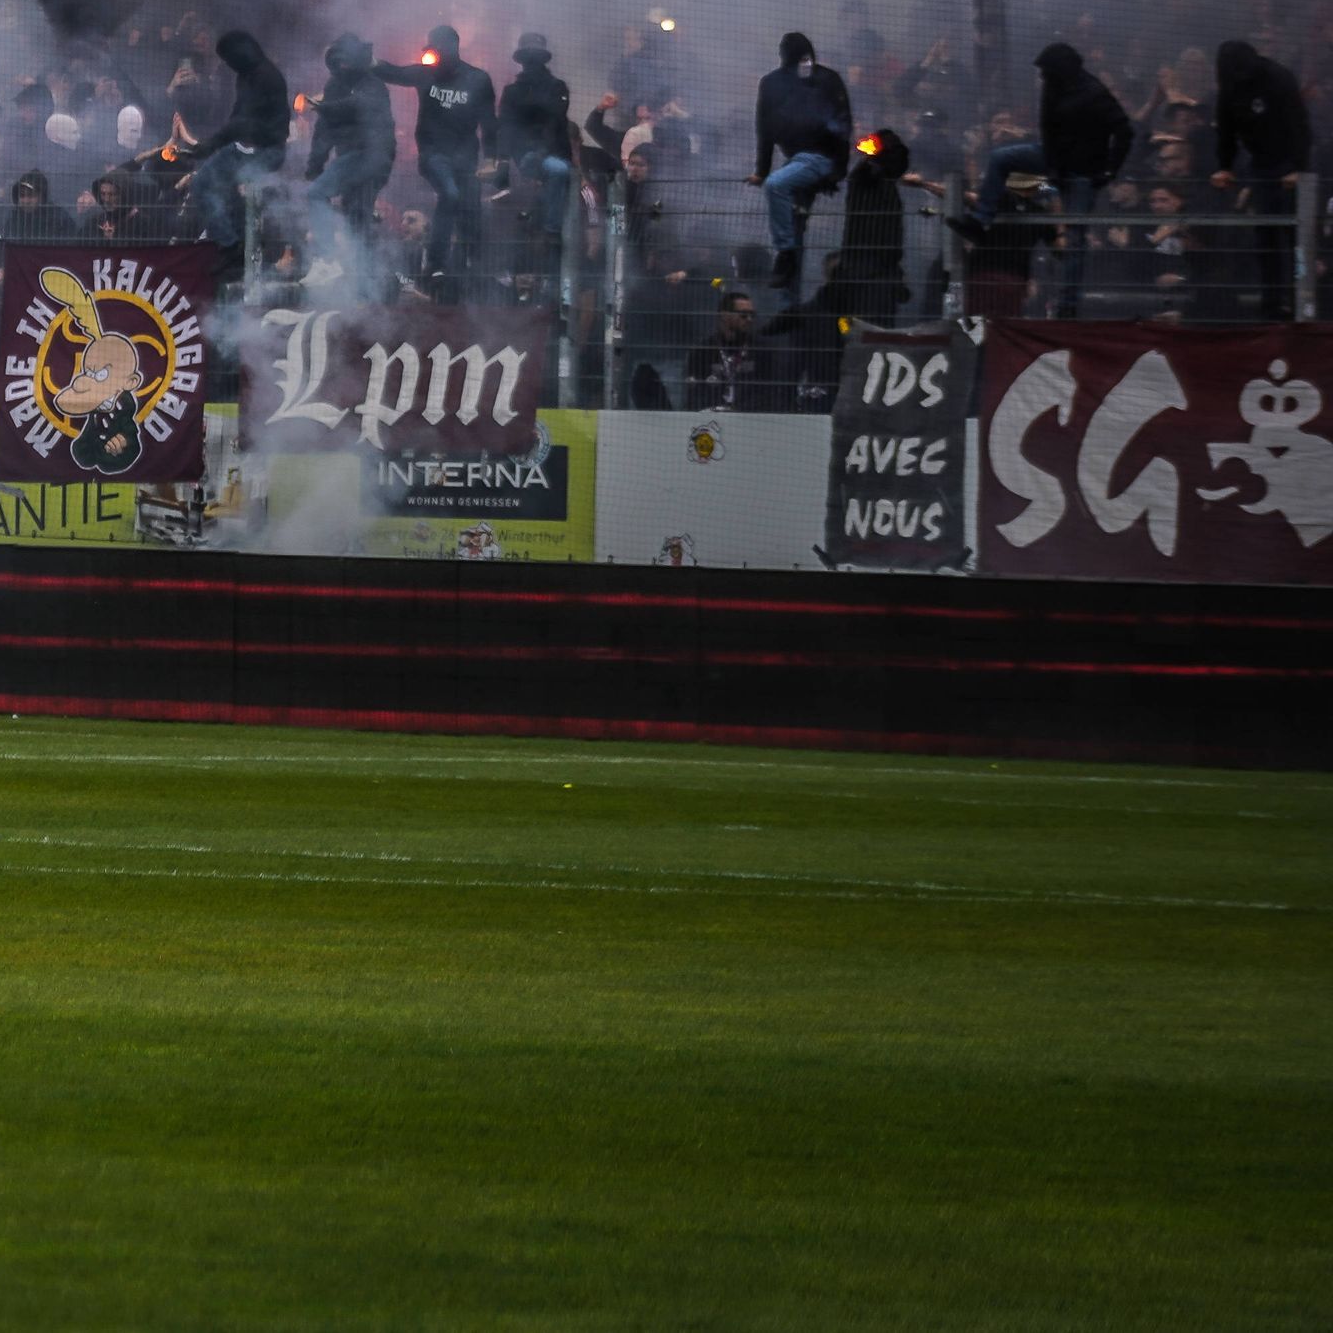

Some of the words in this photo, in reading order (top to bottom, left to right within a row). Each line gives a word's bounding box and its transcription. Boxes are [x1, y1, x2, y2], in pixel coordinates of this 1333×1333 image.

[15, 296, 57, 346] IN
[260, 308, 528, 450] Lpm
[861, 352, 949, 408] IDS
[4, 355, 62, 459] MADE
[377, 460, 550, 489] INTERNA
[844, 434, 947, 477] AVEC
[988, 349, 1188, 558] SG
[406, 496, 454, 507] WOHNEN
[457, 497, 521, 508] GENIESSEN
[844, 498, 943, 542] NOUS
[498, 528, 566, 545] Winterthur
